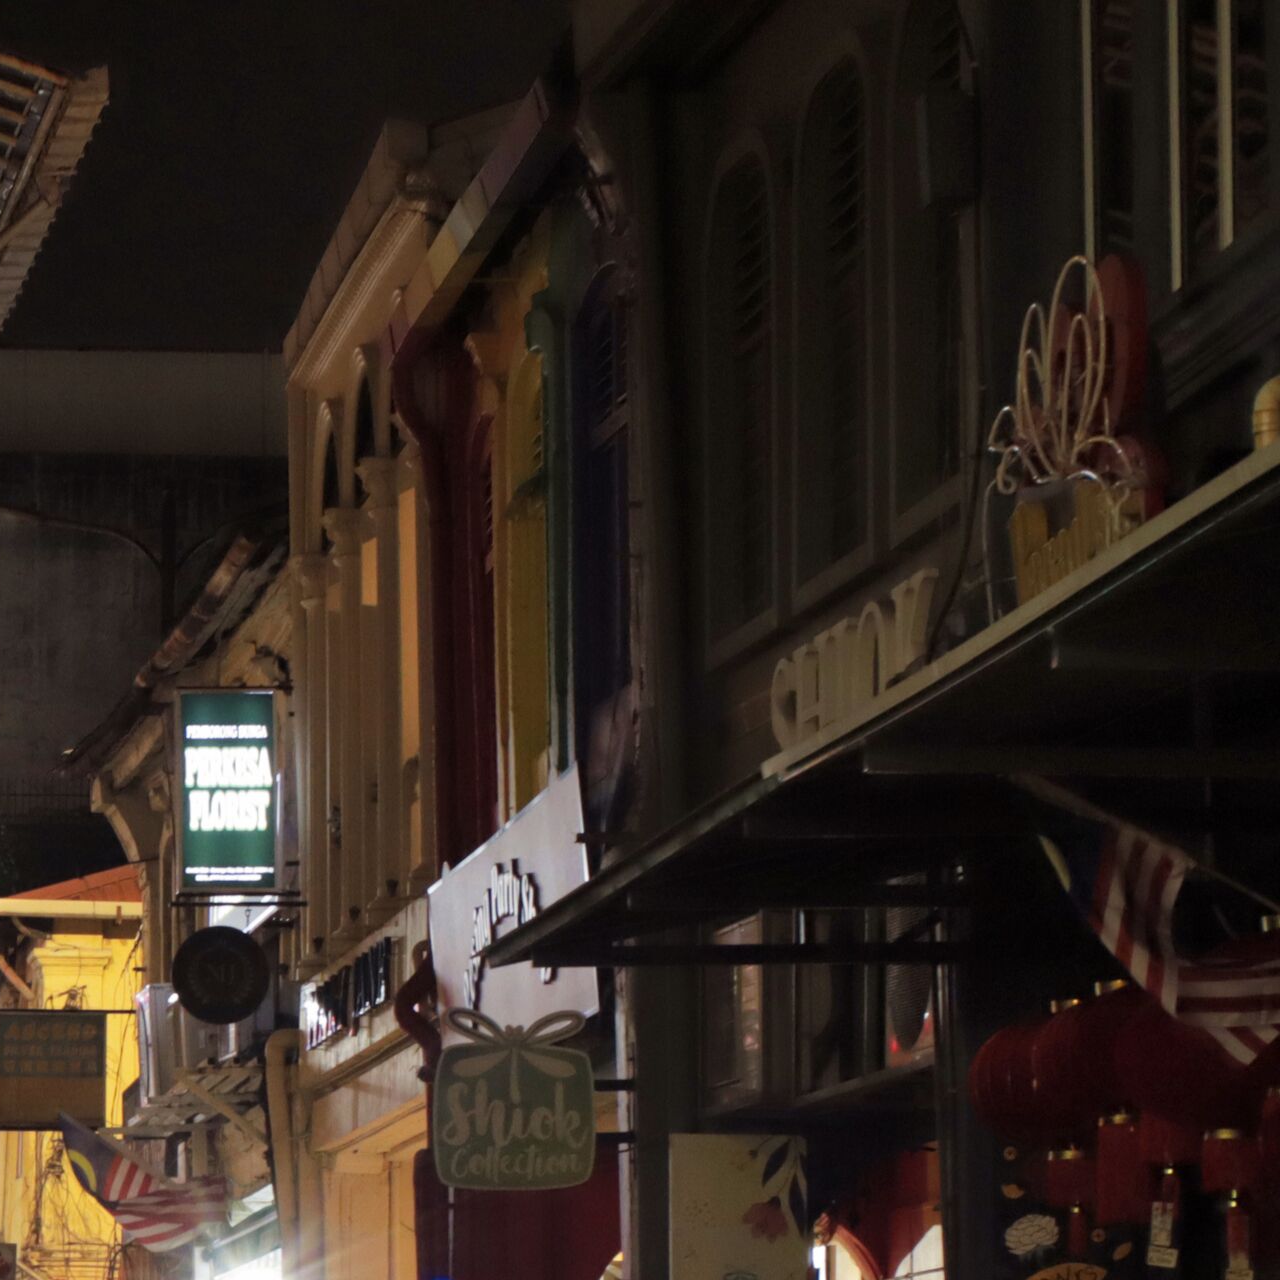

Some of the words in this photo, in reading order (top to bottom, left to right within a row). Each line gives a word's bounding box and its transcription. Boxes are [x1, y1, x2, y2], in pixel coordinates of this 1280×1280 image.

[184, 746, 273, 788] PERKESA
[189, 790, 270, 832] FLORIST
[442, 1078, 589, 1149] Shiok
[451, 1143, 581, 1184] Collection
